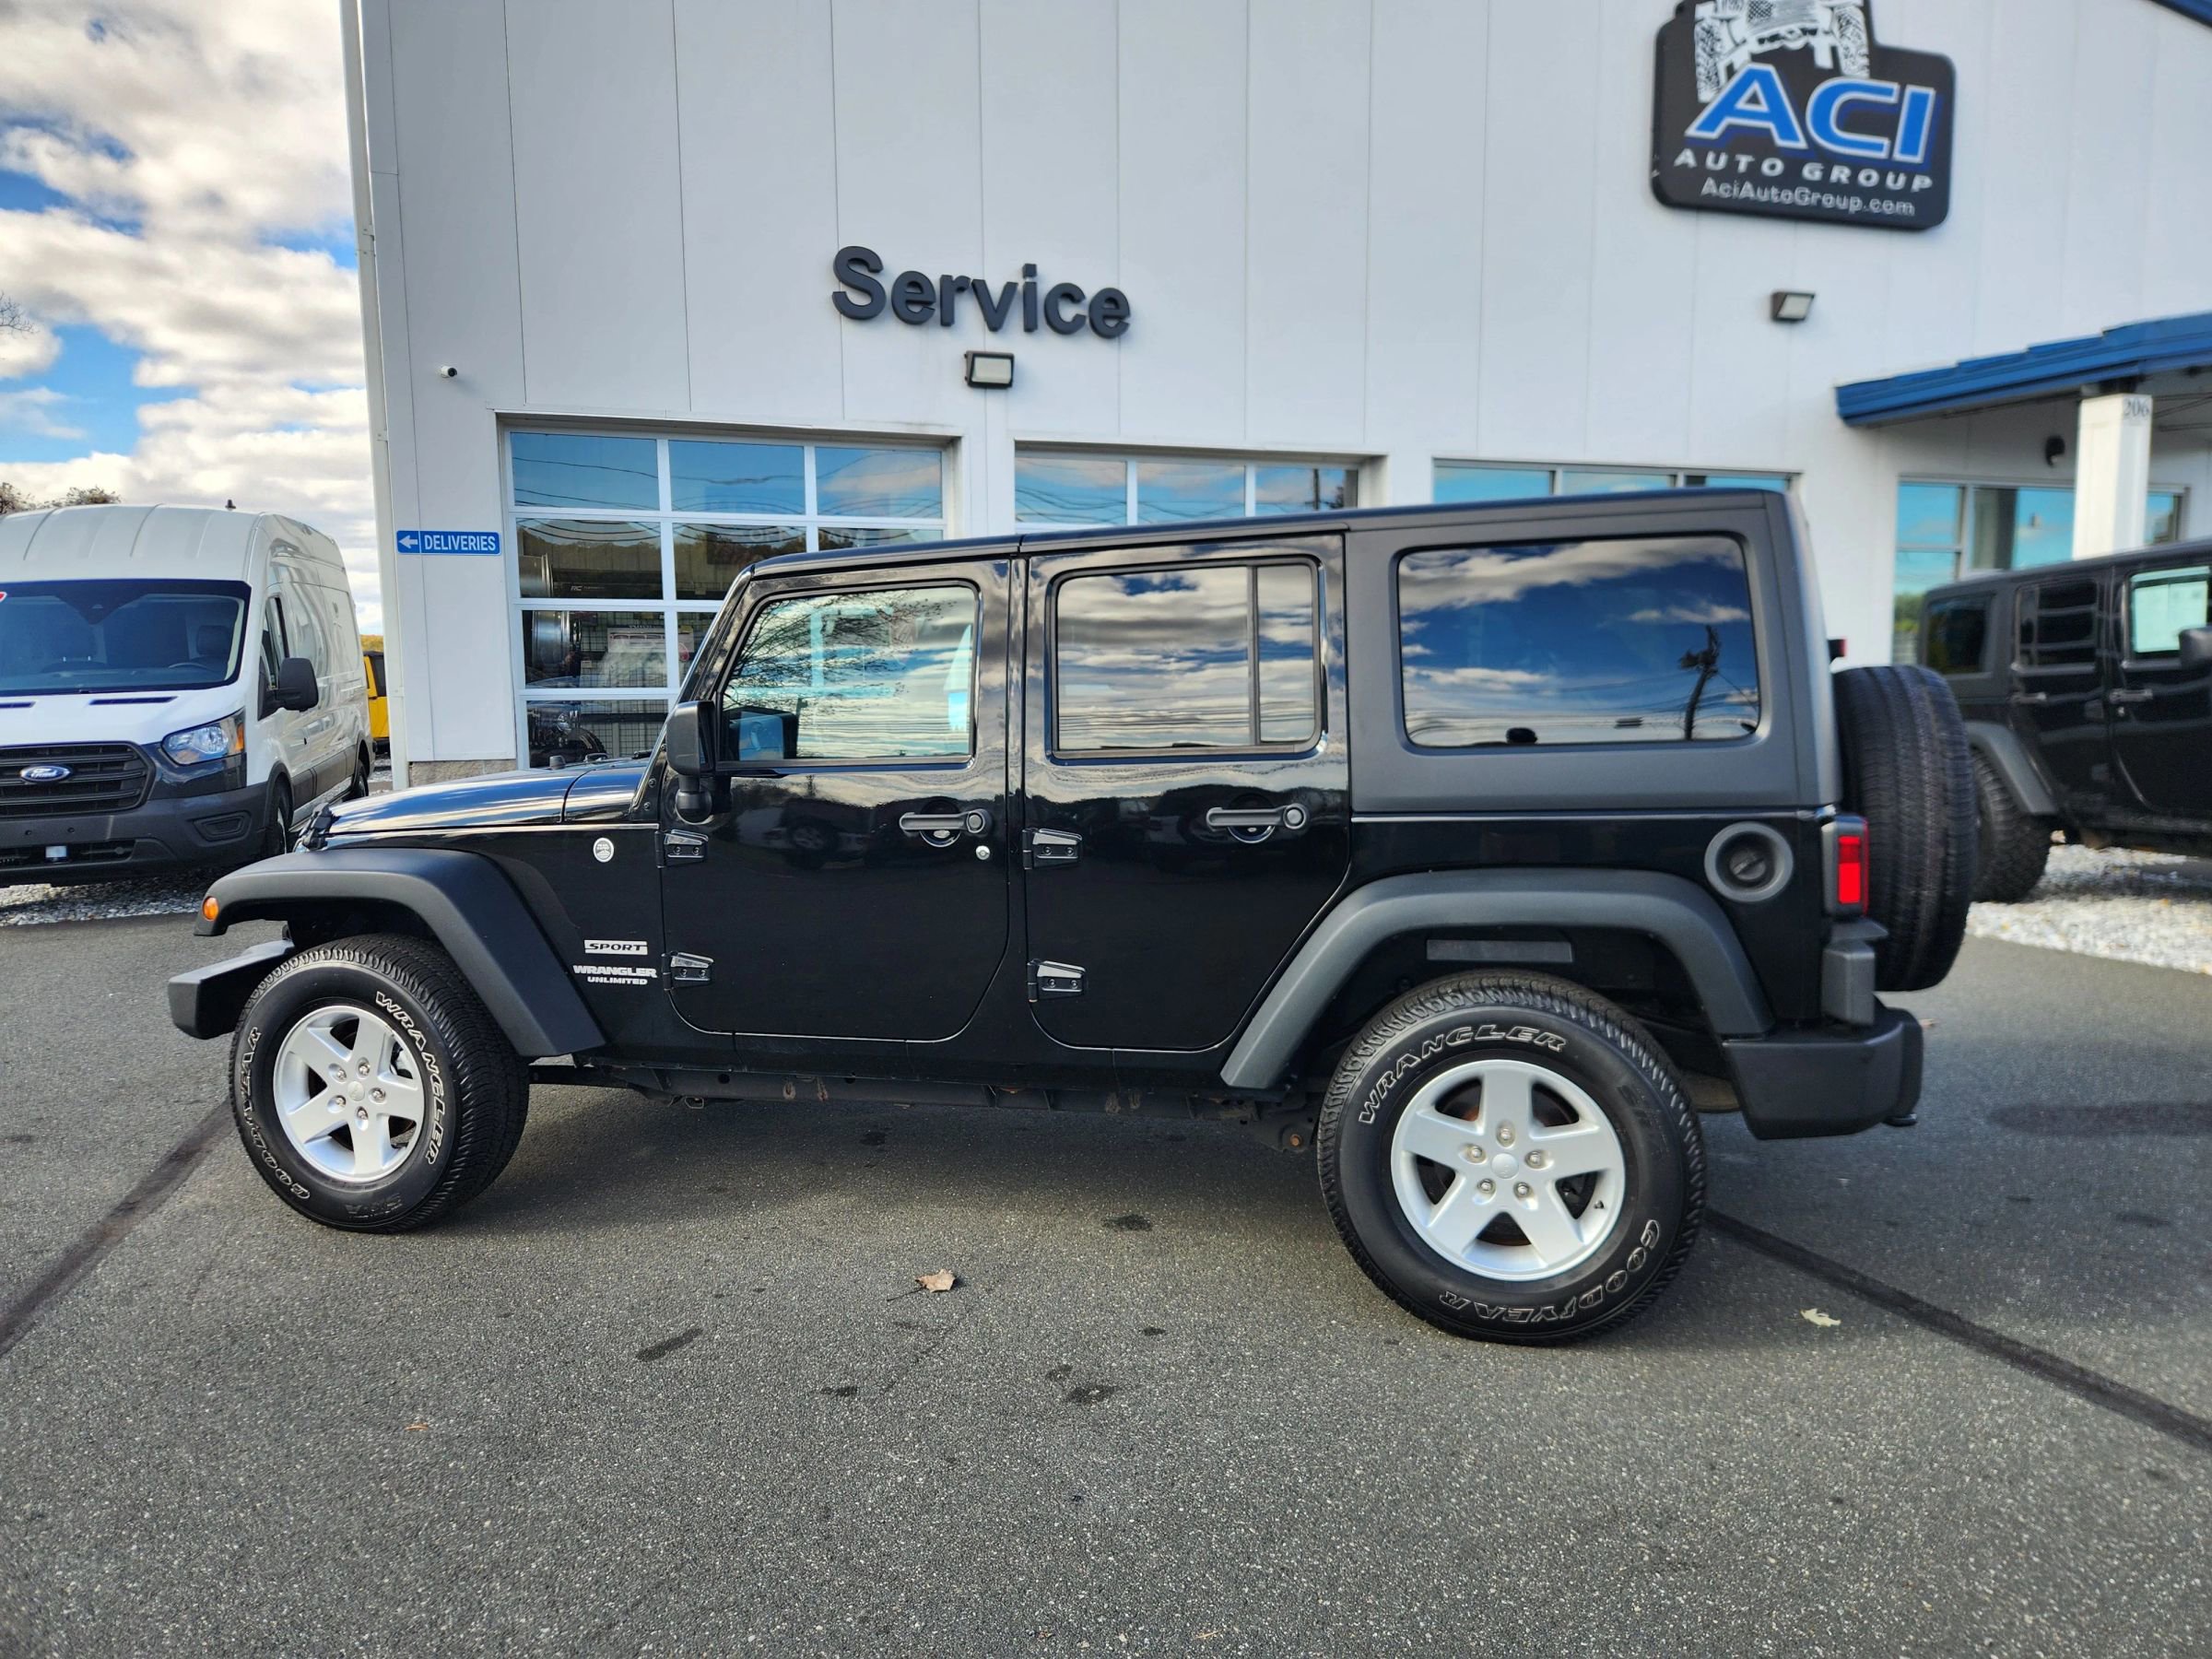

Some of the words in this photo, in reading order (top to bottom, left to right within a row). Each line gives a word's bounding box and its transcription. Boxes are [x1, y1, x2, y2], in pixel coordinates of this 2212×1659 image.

[1684, 62, 1936, 163] ACI
[1674, 147, 1784, 177] AUTO
[1801, 161, 1933, 193] GROUP
[1700, 177, 1915, 218] AciAutoGroup.com
[831, 245, 1131, 339] Service
[424, 535, 496, 551] DELIVERIES
[590, 943, 643, 951] SPORT
[572, 965, 658, 978] WRANGLER
[587, 976, 648, 985] UNLIMITED
[376, 991, 445, 1165] WRANGLER
[1359, 1024, 1568, 1124] WRANGLER
[1439, 1219, 1660, 1324] GOODYEAR
